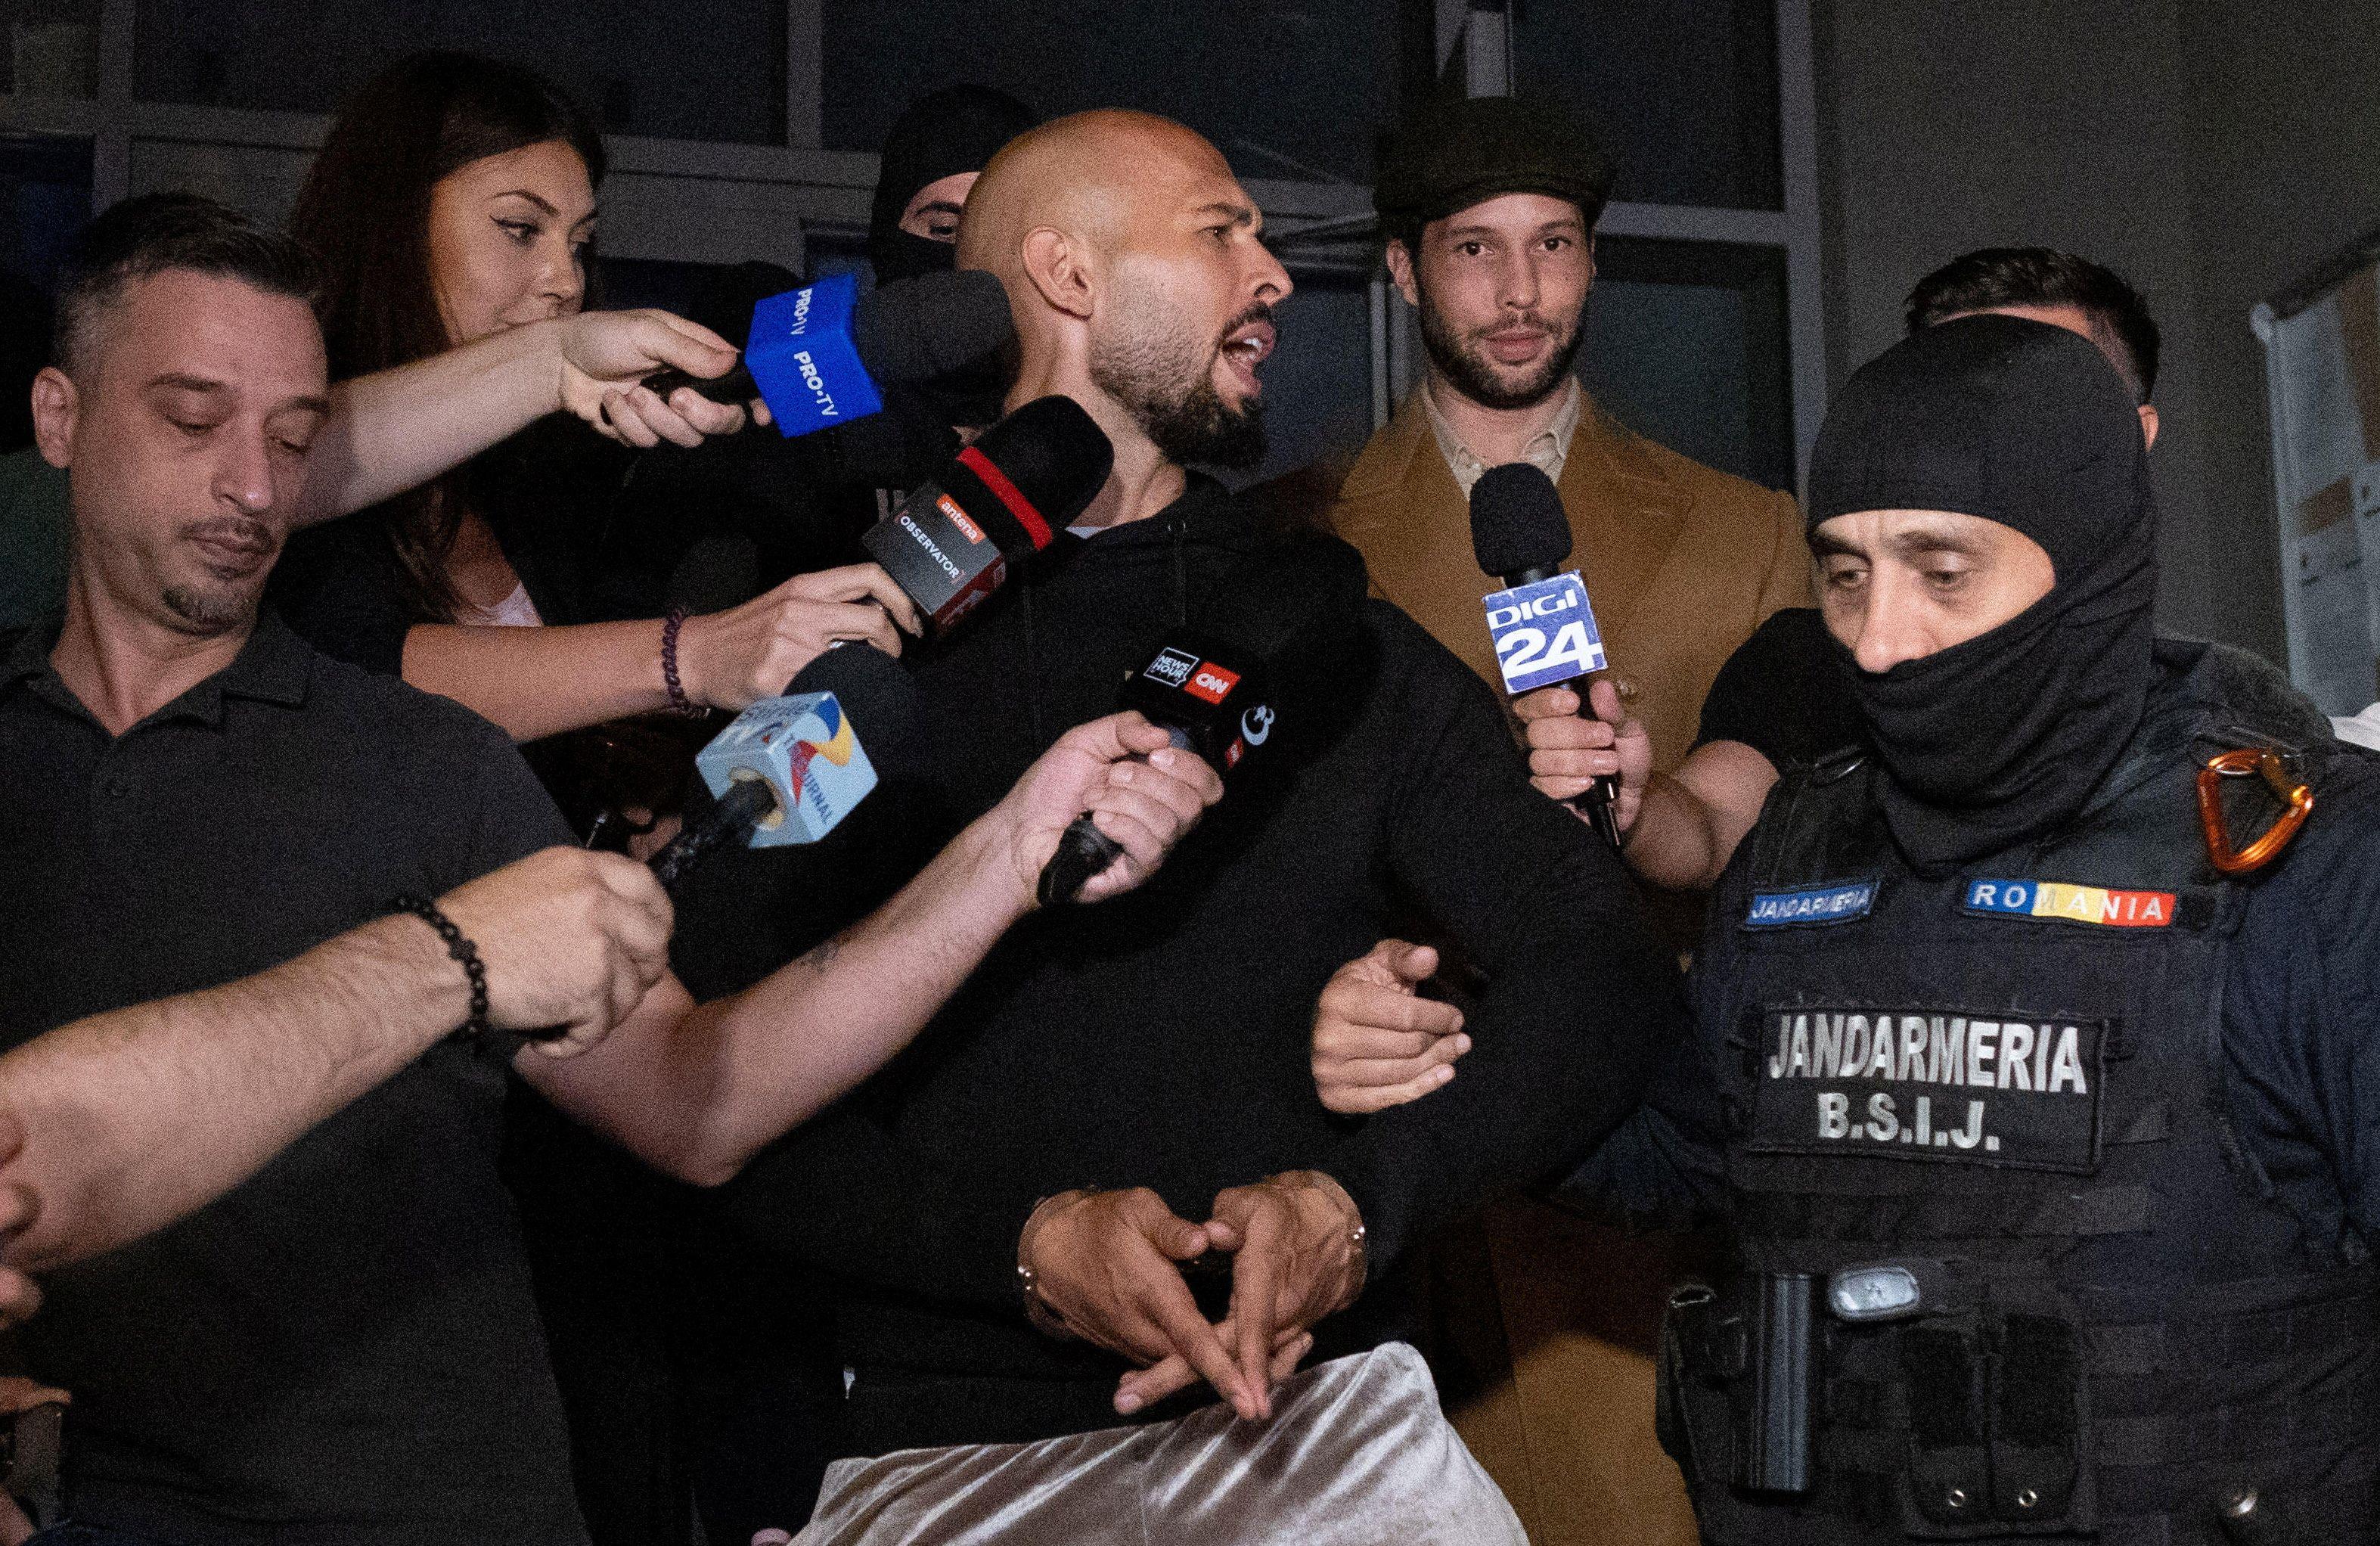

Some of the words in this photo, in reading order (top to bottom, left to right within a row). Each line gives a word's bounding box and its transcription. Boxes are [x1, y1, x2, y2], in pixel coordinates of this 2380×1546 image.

[942, 501, 978, 540] antena
[900, 515, 960, 579] OBSERVATOR
[1486, 588, 1579, 630] DIGI
[1157, 655, 1191, 672] NEWS
[1495, 619, 1603, 679] 24
[1150, 663, 1184, 679] HOUR
[1196, 672, 1230, 694] CNN
[1752, 888, 1870, 919] JANDARMERIA
[1972, 883, 2164, 921] ROMANIA
[1769, 1012, 2089, 1095] JANDARMERIA
[1817, 1091, 2002, 1151] B.S.I.J.
